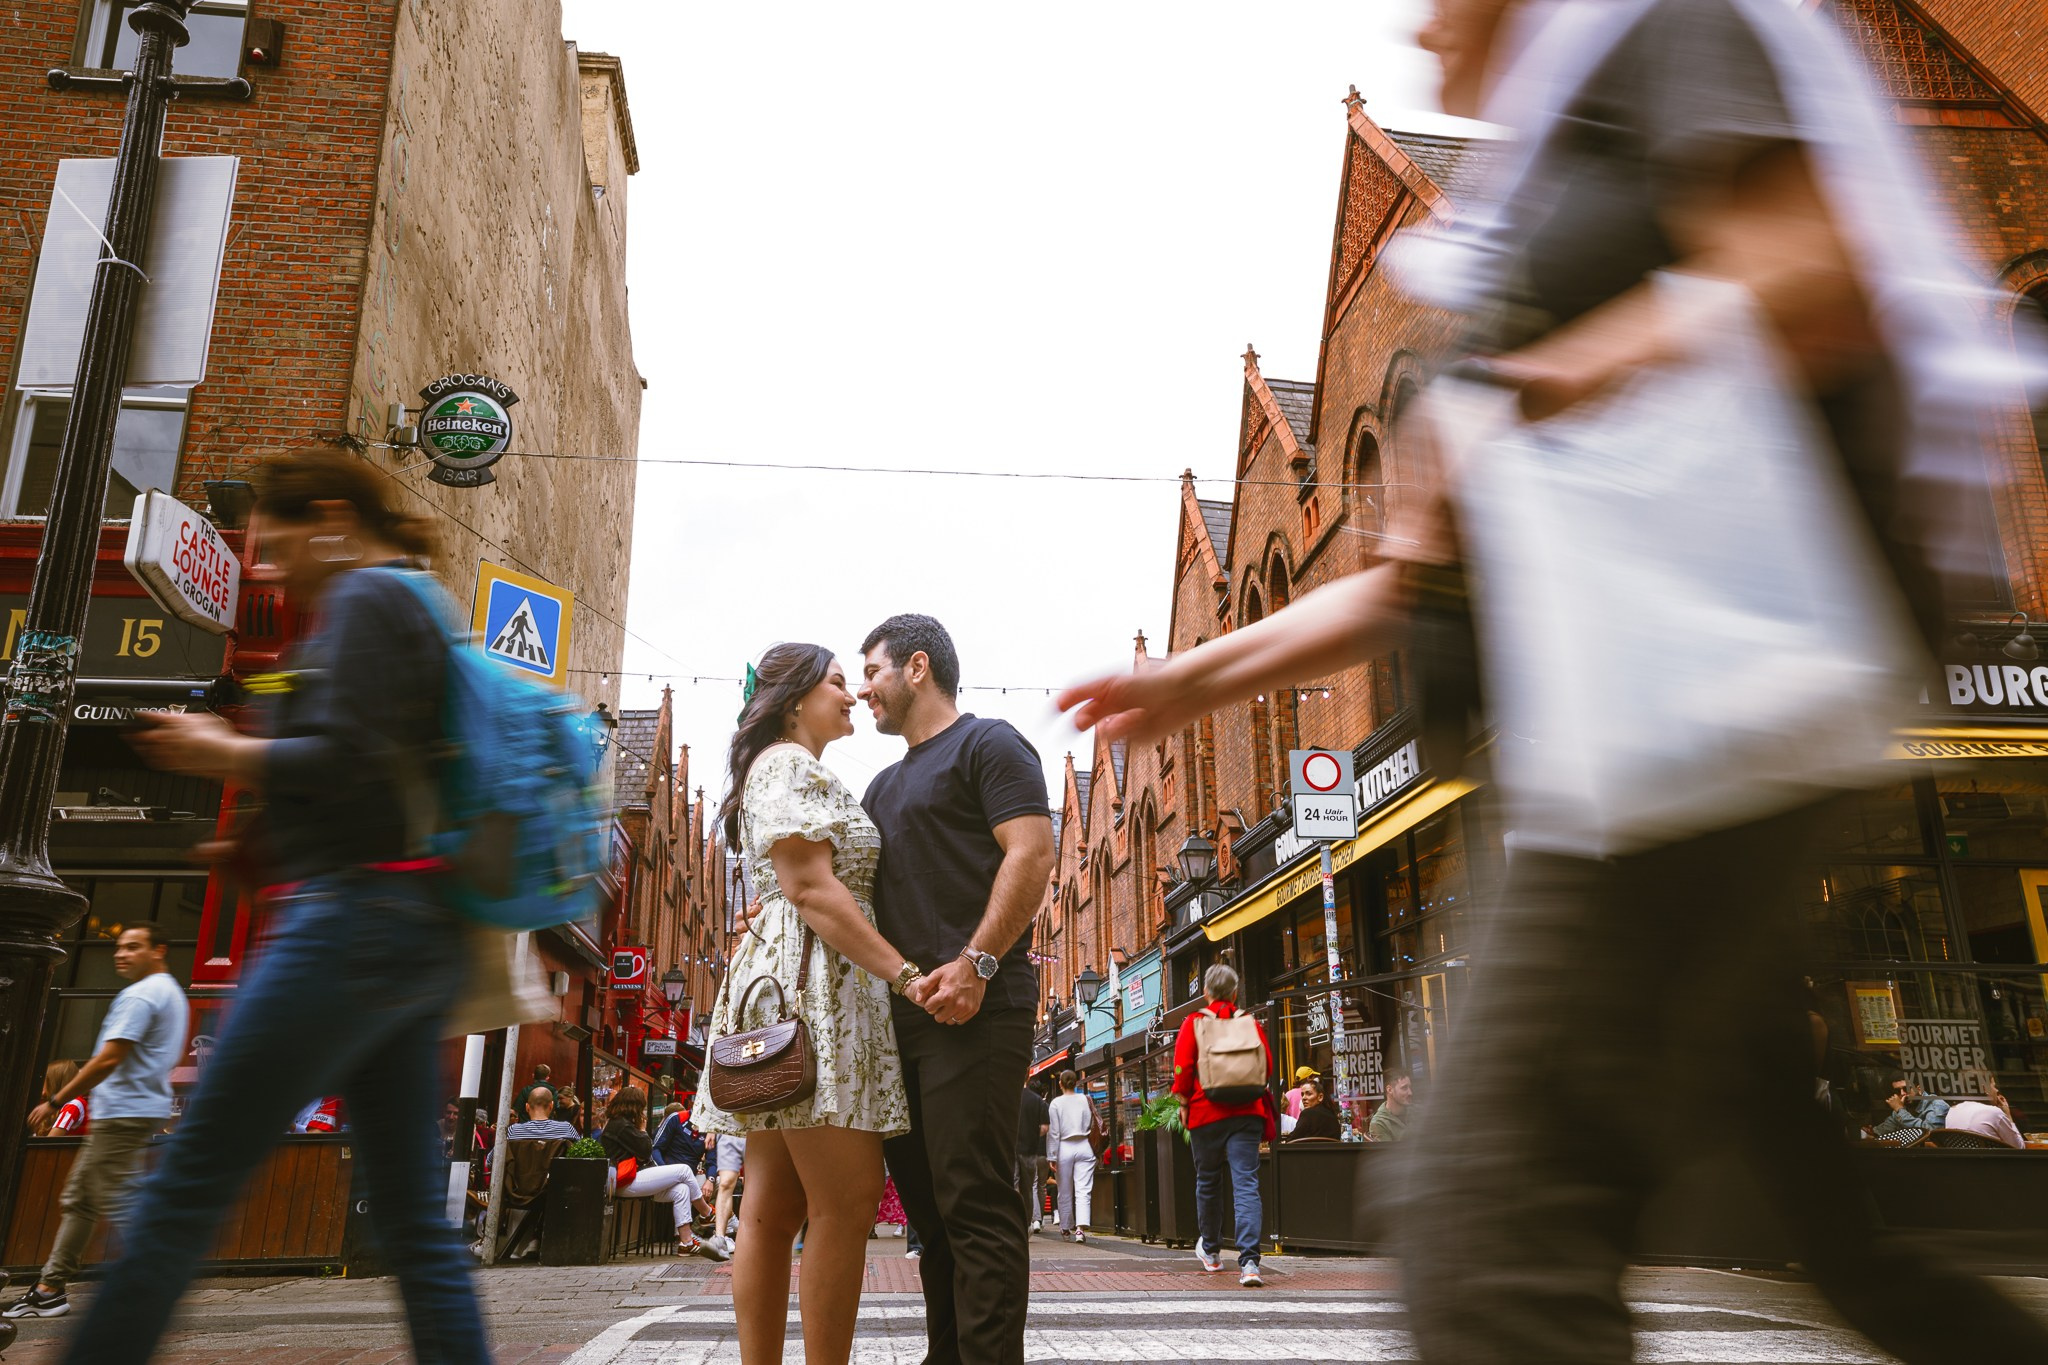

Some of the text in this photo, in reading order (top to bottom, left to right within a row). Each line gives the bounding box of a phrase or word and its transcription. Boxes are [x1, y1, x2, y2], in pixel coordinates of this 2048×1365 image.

[428, 373, 511, 398] GROGAN'S
[427, 418, 503, 435] Heineken
[442, 468, 478, 481] BAR
[201, 519, 217, 544] THE
[180, 521, 231, 584] CASTLE
[173, 540, 229, 611] LOUNGE
[174, 573, 221, 622] J. GROGAN
[115, 618, 164, 657] 15
[1902, 742, 2034, 757] GOURMET
[1362, 739, 1420, 808] KITCHEN
[1304, 808, 1320, 821] 24
[1276, 877, 1302, 907] GOURMET
[1332, 1032, 1382, 1054] GOURMET
[1899, 1025, 1980, 1046] GOURMET
[1333, 1051, 1383, 1076] BURGER
[1901, 1047, 1988, 1071] BURGER
[1903, 1071, 1992, 1094] KITCHEN
